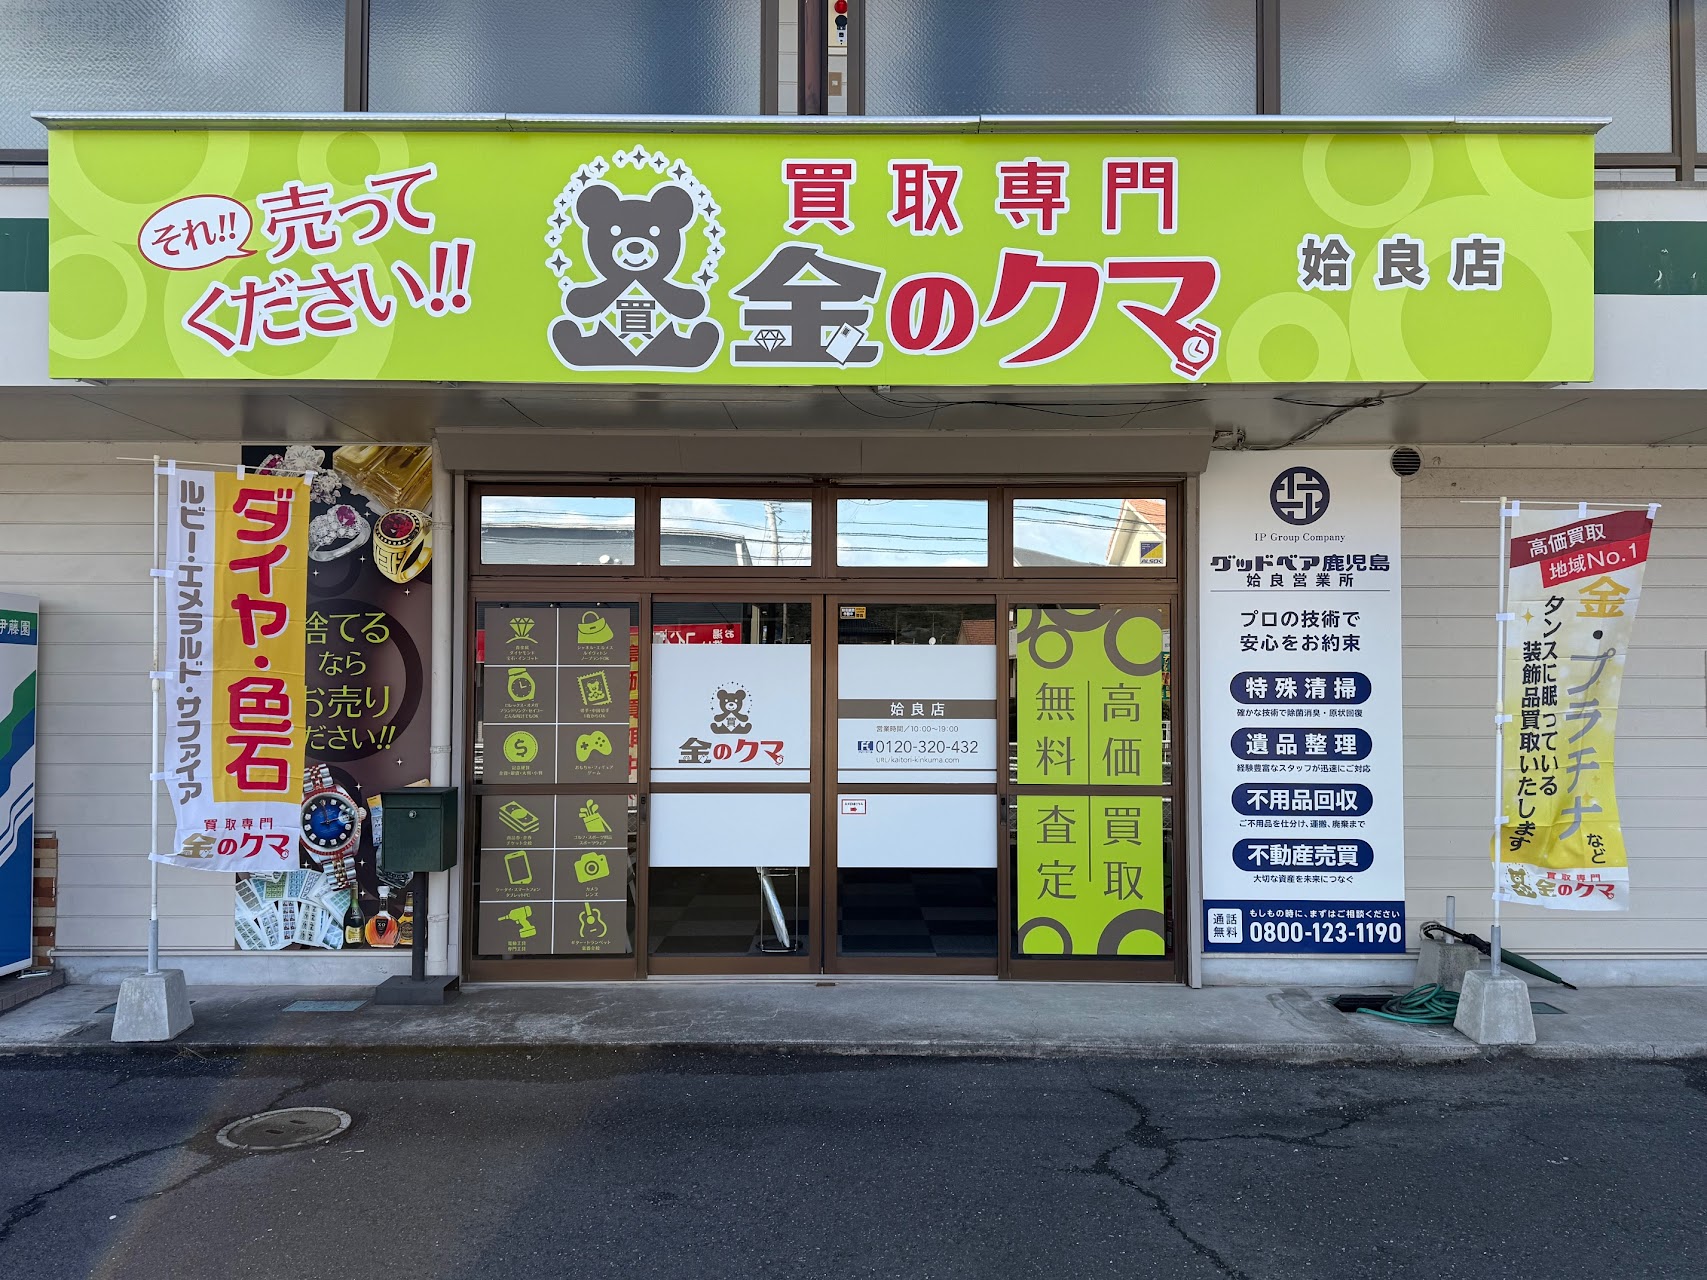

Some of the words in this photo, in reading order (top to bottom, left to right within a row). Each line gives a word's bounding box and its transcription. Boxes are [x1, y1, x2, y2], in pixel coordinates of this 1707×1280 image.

[783, 158, 1179, 235] 買取専門
[261, 163, 437, 258] 売って
[150, 210, 238, 256] それ!!
[1297, 234, 1506, 292] 姶良店
[184, 238, 474, 355] ください!!
[730, 242, 1221, 380] 金のクマ
[1254, 532, 1267, 542] IP
[1270, 532, 1300, 543] Group
[1302, 532, 1346, 543] Company
[1528, 523, 1606, 558] 高価買取
[1210, 554, 1391, 572] グッドベア鹿児島
[1549, 543, 1637, 580] 地域No.1
[1246, 573, 1354, 588] 姶良営業所
[1240, 610, 1361, 629] プロの技術で
[176, 479, 205, 805] ルビー・エメラルド・サファイア
[225, 487, 295, 793] ダイヤ・色石
[1239, 633, 1361, 652] 安心をお約束
[318, 651, 368, 676] なら
[1245, 677, 1357, 700] 特殊清掃
[1539, 595, 1565, 797] タンスに眠っている
[890, 702, 945, 717] 姶良店
[305, 724, 397, 750] ださい!!
[875, 740, 979, 753] 0120-320-432
[1246, 733, 1358, 756] 遺品整理
[1509, 640, 1542, 852] 装飾品買取いたします
[678, 736, 785, 766] 金のクマ
[1246, 789, 1359, 811] 不用品回収
[203, 818, 273, 832] 買取専門
[179, 833, 290, 860] 金のクマ
[1247, 844, 1359, 867] 不動産売買
[1587, 833, 1606, 865] など
[1253, 874, 1354, 884] 大切な資産を未来につなぐ
[1546, 871, 1601, 882] 買取専門
[1535, 879, 1616, 900] 金のクマ
[1212, 913, 1238, 925] 通話
[1212, 926, 1239, 938] 無料
[1249, 922, 1402, 943] 0800-123-1190
